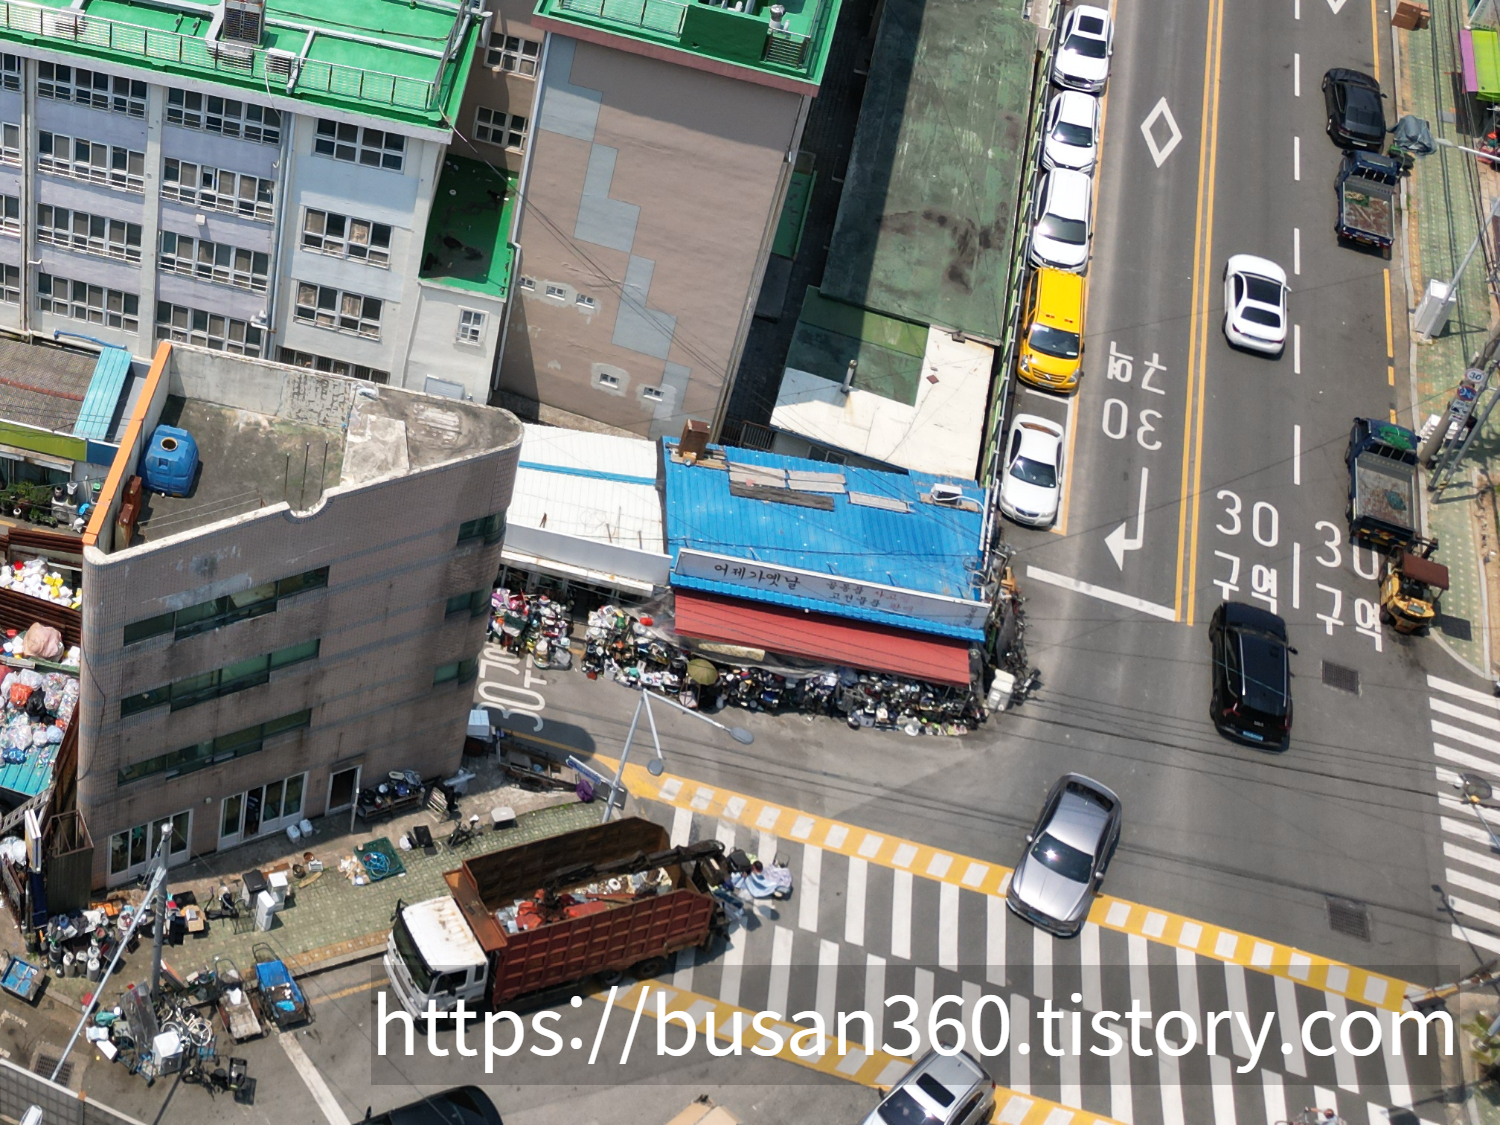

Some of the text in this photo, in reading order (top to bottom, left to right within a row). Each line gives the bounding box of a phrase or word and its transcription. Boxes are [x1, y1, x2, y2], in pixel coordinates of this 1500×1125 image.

[1107, 340, 1168, 396] 구역
[1469, 371, 1482, 381] 30
[1102, 398, 1163, 451] 30
[1216, 489, 1279, 548] 30
[1315, 520, 1379, 581] 30
[1213, 550, 1278, 615] 구역
[1315, 582, 1383, 653] 구역
